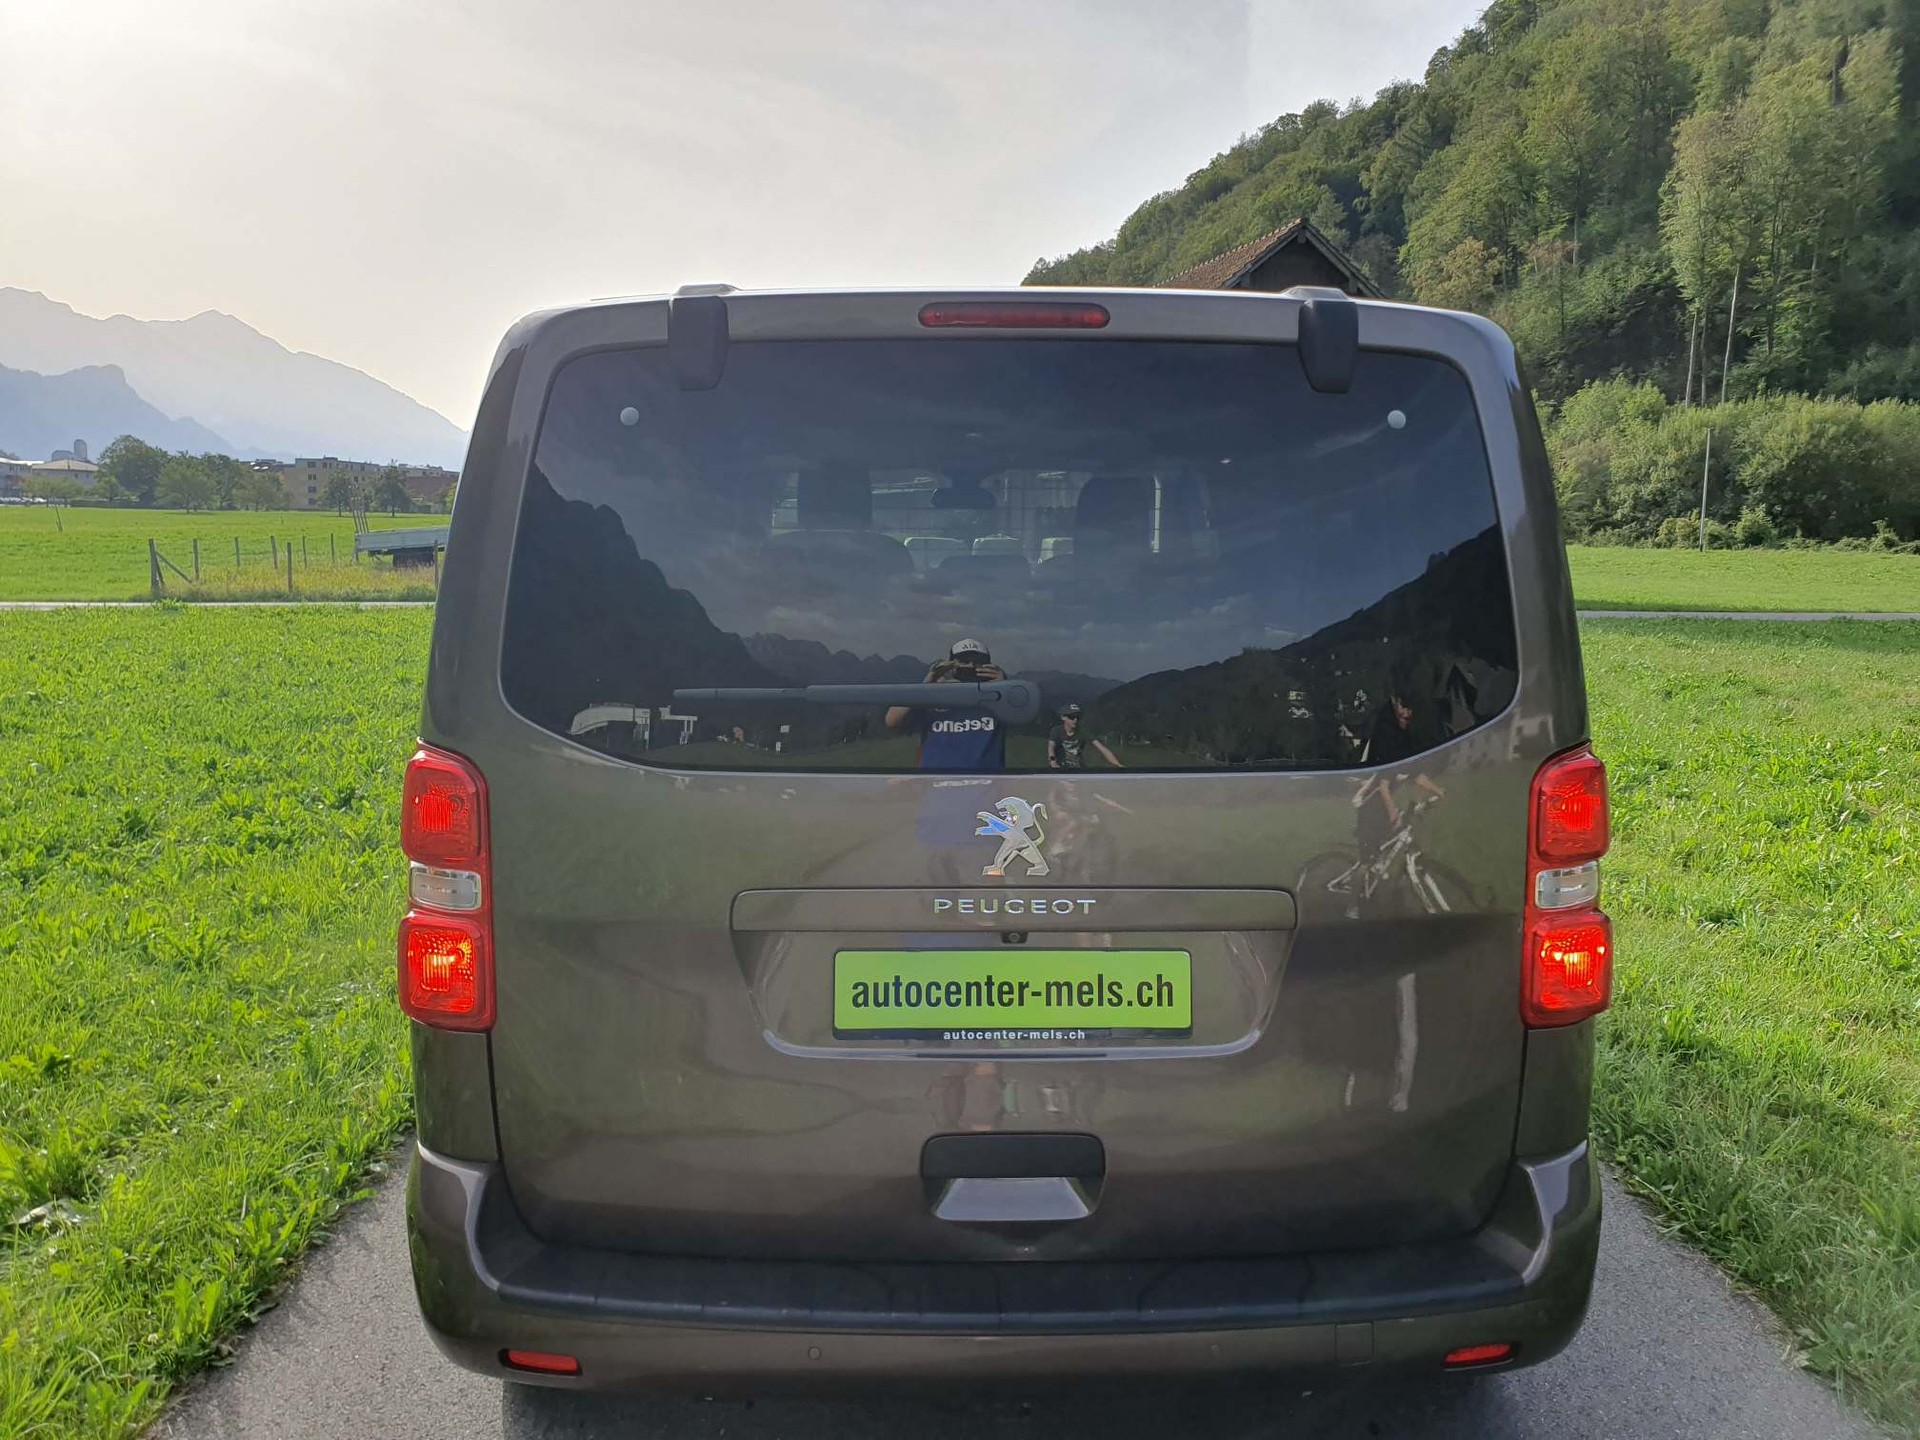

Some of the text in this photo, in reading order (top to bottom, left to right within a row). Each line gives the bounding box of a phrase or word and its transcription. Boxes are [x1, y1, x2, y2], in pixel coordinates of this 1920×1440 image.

[933, 898, 1097, 914] PEUGEOT
[851, 974, 1174, 1008] autocenter-mels.ch
[943, 1029, 1086, 1041] autocenter-mels.ch
